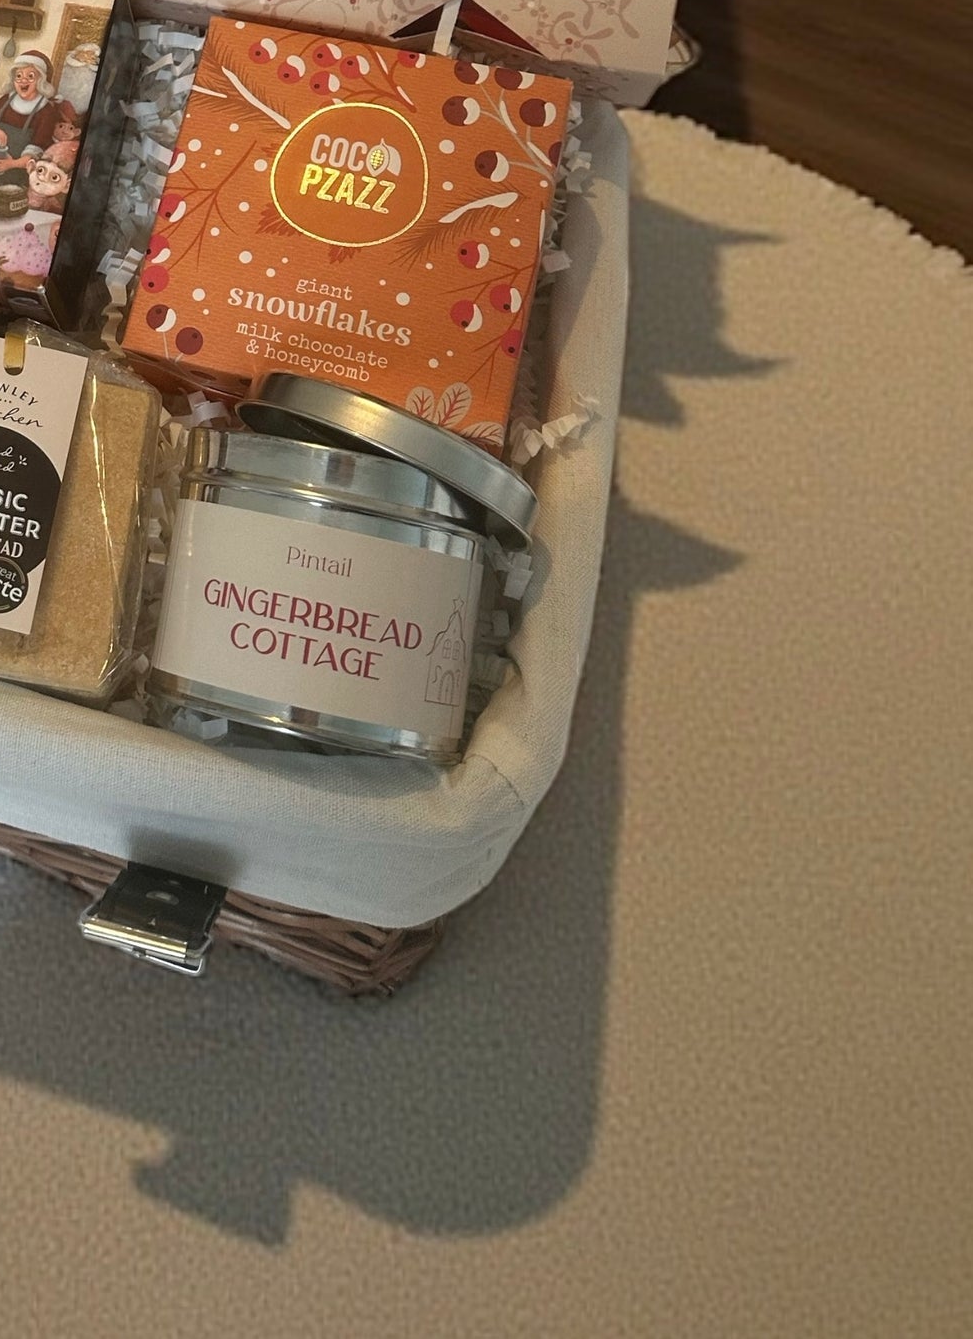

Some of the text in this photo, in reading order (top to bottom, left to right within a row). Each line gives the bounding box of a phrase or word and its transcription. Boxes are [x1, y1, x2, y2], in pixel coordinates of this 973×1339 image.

[310, 133, 402, 177] COCO
[299, 163, 396, 214] PZAZZ
[295, 278, 353, 301] giant
[227, 287, 412, 347] snowflakes
[235, 322, 389, 369] milk chocolate
[245, 339, 370, 382] & honeycomb
[285, 545, 354, 578] Pintail
[203, 578, 423, 650] GINGERBREAD
[230, 622, 384, 681] COTTAGE
